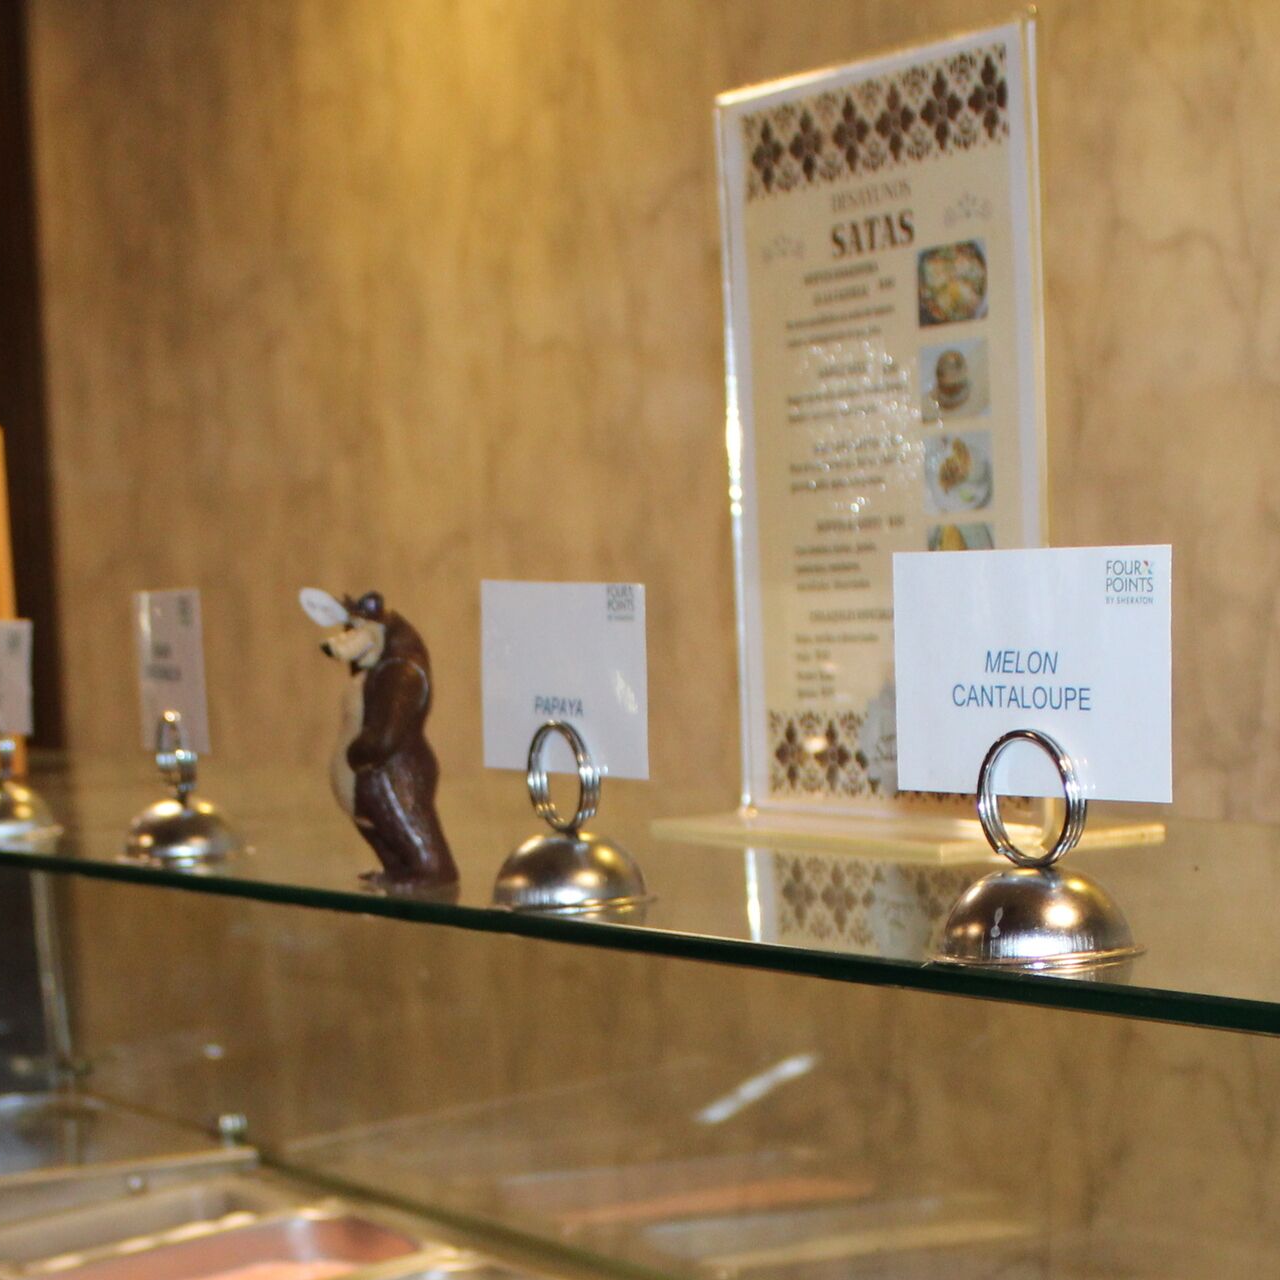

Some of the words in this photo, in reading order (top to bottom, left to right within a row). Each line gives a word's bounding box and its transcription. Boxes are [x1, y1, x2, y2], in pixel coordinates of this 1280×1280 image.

[831, 209, 915, 259] SATAS
[1106, 560, 1142, 575] FOUR
[1106, 577, 1153, 592] POINTS
[985, 650, 1058, 674] MELON
[534, 696, 584, 717] PAPAYA
[952, 684, 1091, 711] CANTALOUPE
